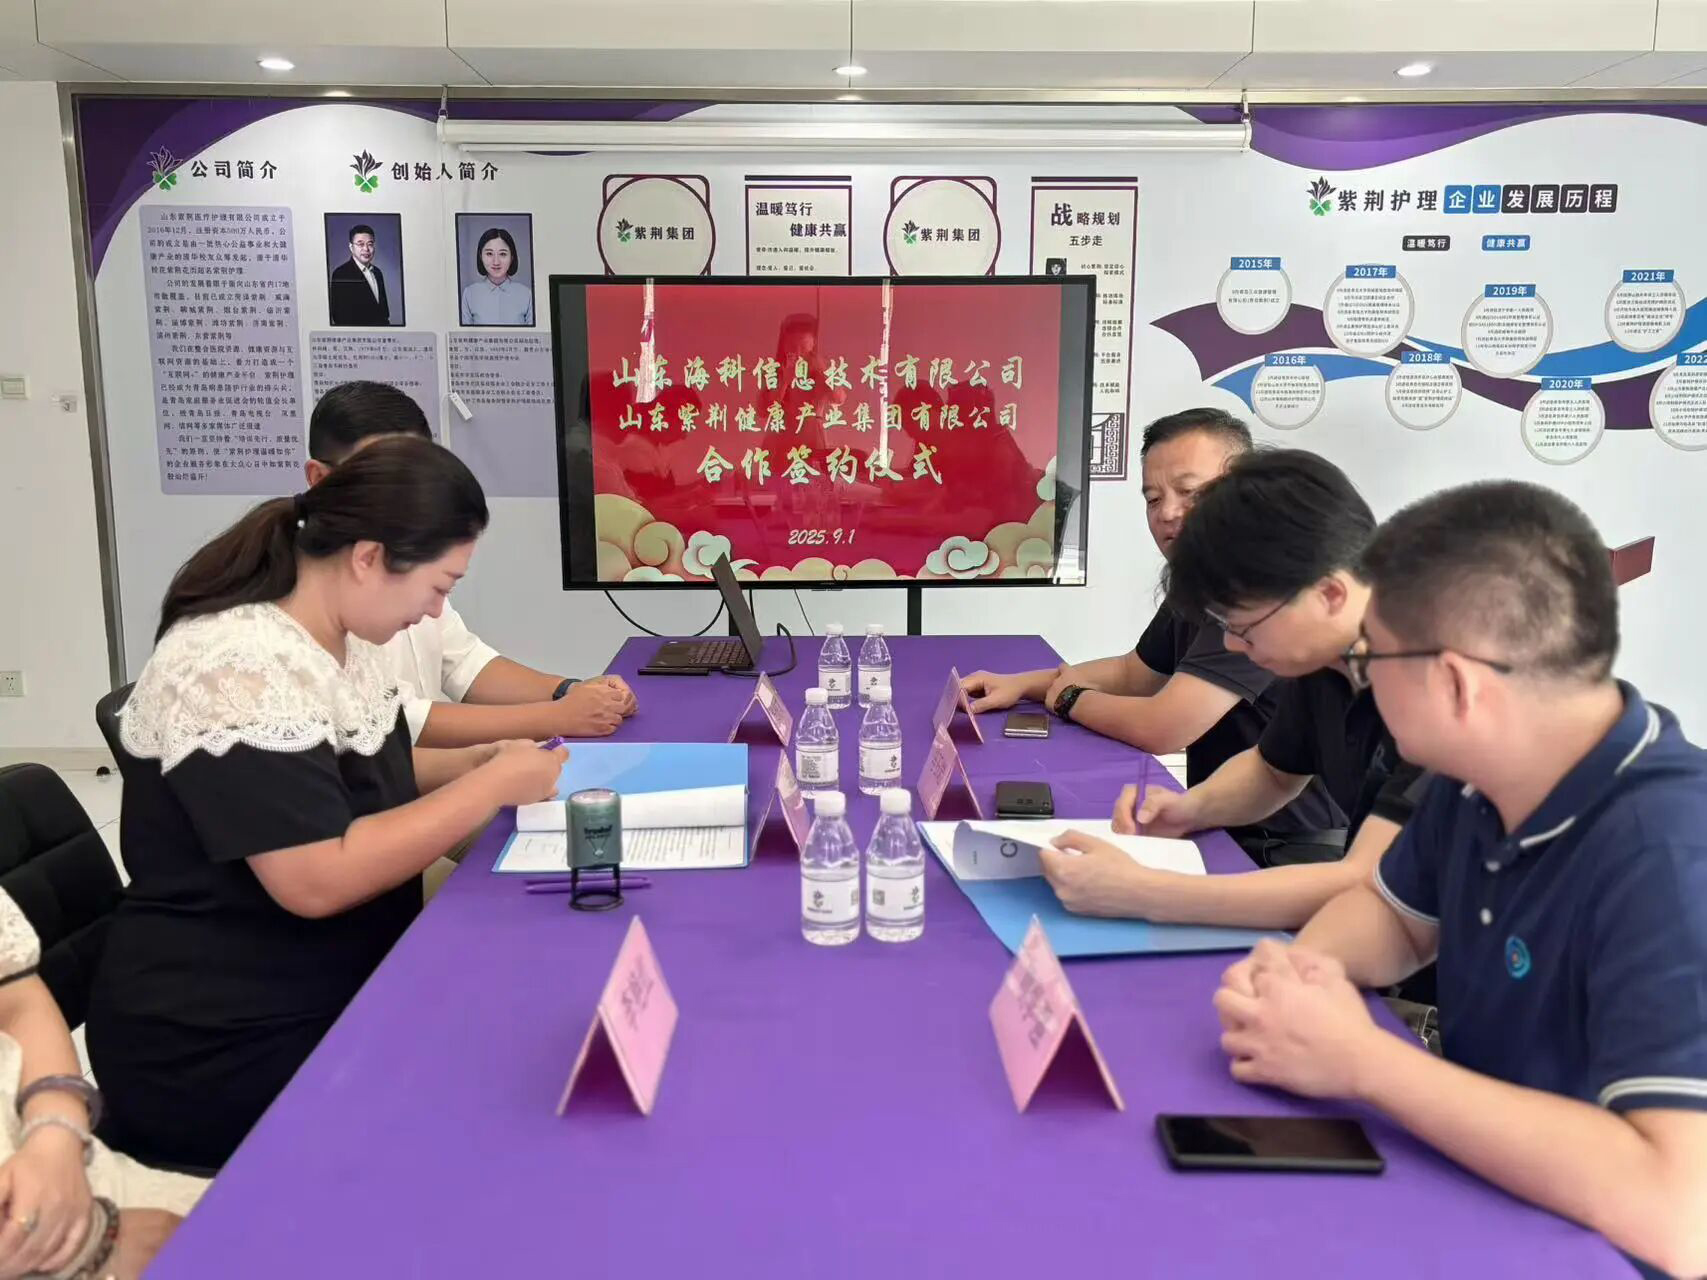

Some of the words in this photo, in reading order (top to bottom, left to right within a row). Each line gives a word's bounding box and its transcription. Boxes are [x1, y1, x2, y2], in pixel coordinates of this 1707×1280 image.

[191, 160, 278, 180] 公司简介
[390, 161, 499, 181] 创始人简介
[1338, 188, 1613, 211] 紫荆护理企业发展历程
[755, 202, 813, 217] 温暖笃行
[1050, 202, 1121, 226] 战略规划
[635, 226, 695, 241] 紫荆集团
[789, 222, 848, 238] 健康共赢
[920, 227, 981, 242] 紫荆集团
[1069, 235, 1103, 247] 五步走
[1406, 238, 1448, 249] 温暖笃行
[1486, 238, 1526, 249] 健康共赢
[1239, 258, 1273, 269] 2015年
[1353, 267, 1388, 277] 2017年
[1630, 271, 1666, 281] 2021年
[1492, 286, 1528, 296] 2019年
[1272, 355, 1307, 365] 2016年
[1408, 352, 1443, 362] 2018年
[1549, 379, 1584, 389] 2020年
[619, 400, 1018, 434] 山东紫荆健康产业集团有限公司
[697, 442, 943, 485] 合作签约仪式
[788, 528, 855, 546] 2025.9.1
